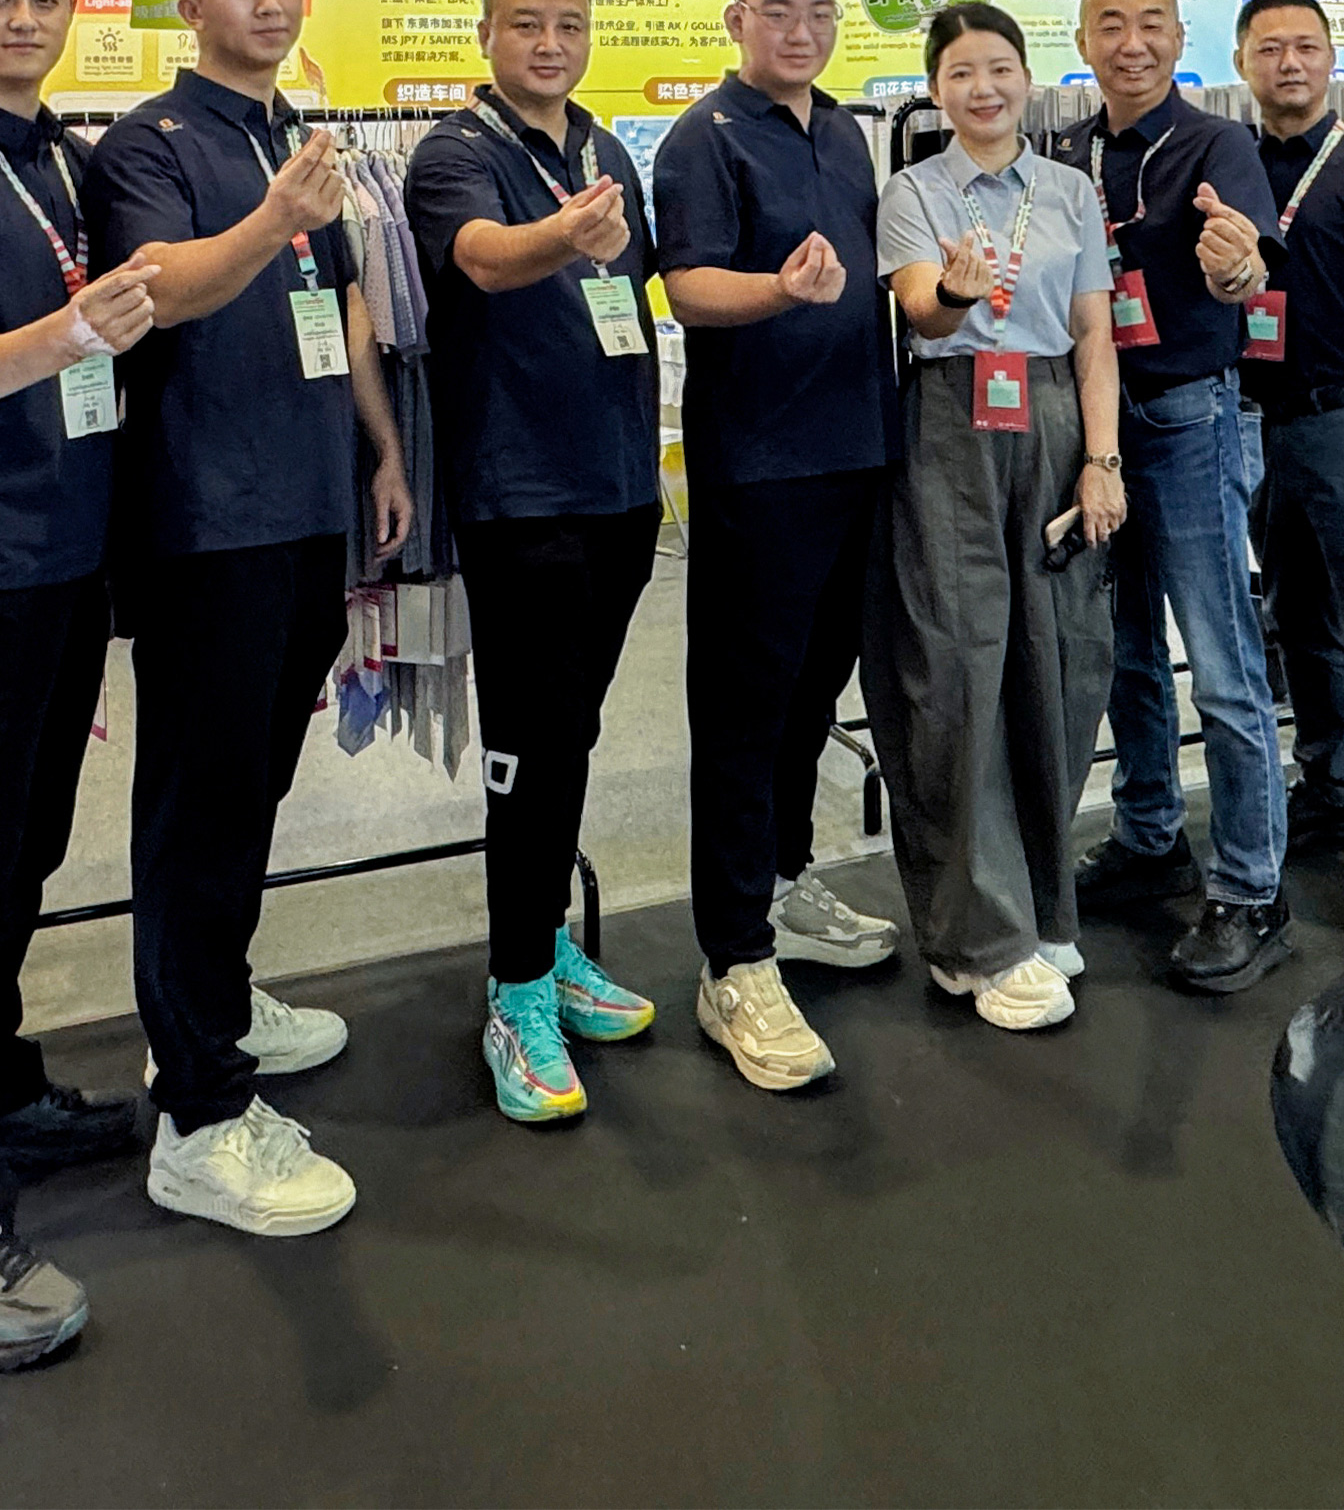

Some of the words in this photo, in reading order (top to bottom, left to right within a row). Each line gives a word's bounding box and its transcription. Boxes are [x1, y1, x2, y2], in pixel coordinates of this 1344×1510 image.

[429, 35, 472, 45] SANTEX
[396, 83, 467, 101] 织造车间
